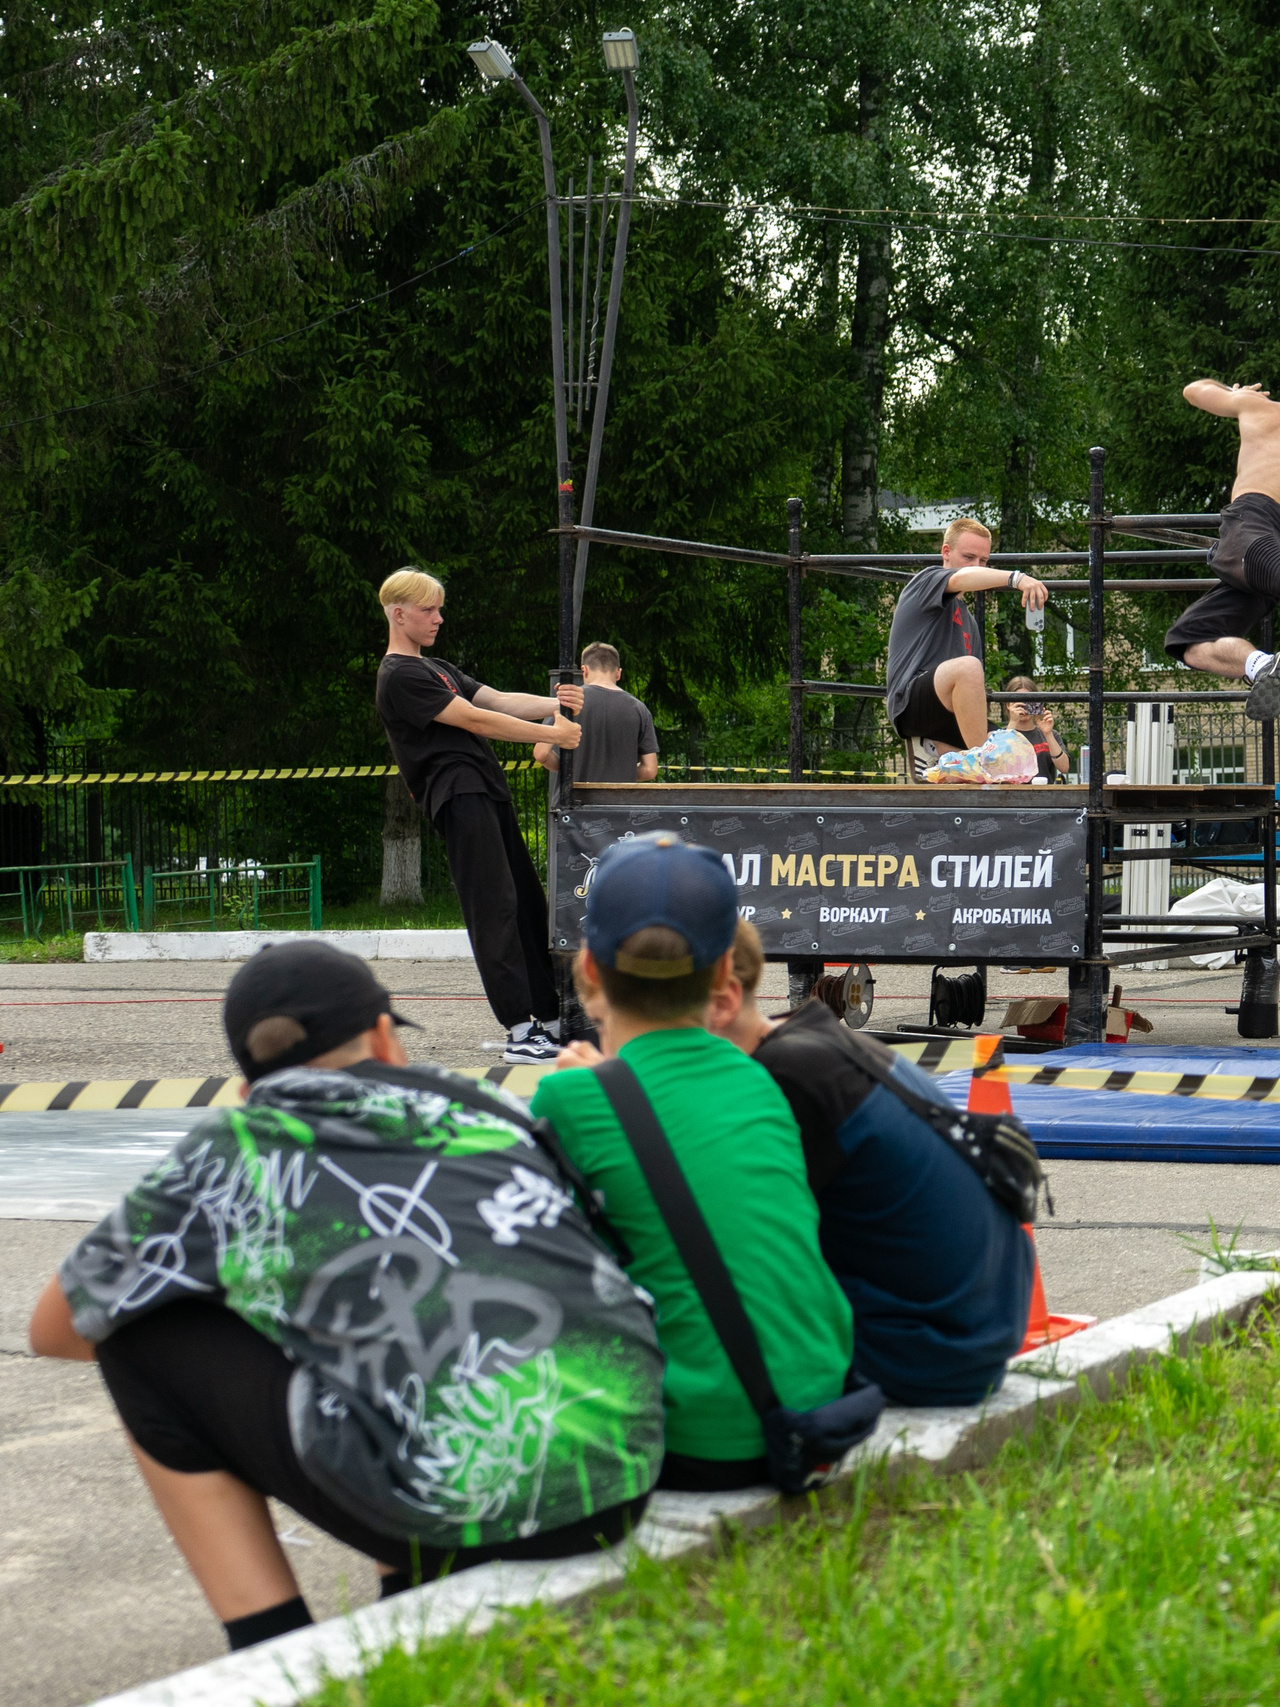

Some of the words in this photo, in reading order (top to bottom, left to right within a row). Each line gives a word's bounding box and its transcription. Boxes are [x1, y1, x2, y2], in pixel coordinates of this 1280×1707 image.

[770, 853, 920, 888] МАСТЕРА
[930, 849, 1054, 888] СТИЛЕЙ
[819, 906, 890, 923] ВОРКАУТ
[952, 908, 1053, 925] АКРОБАТИКА
